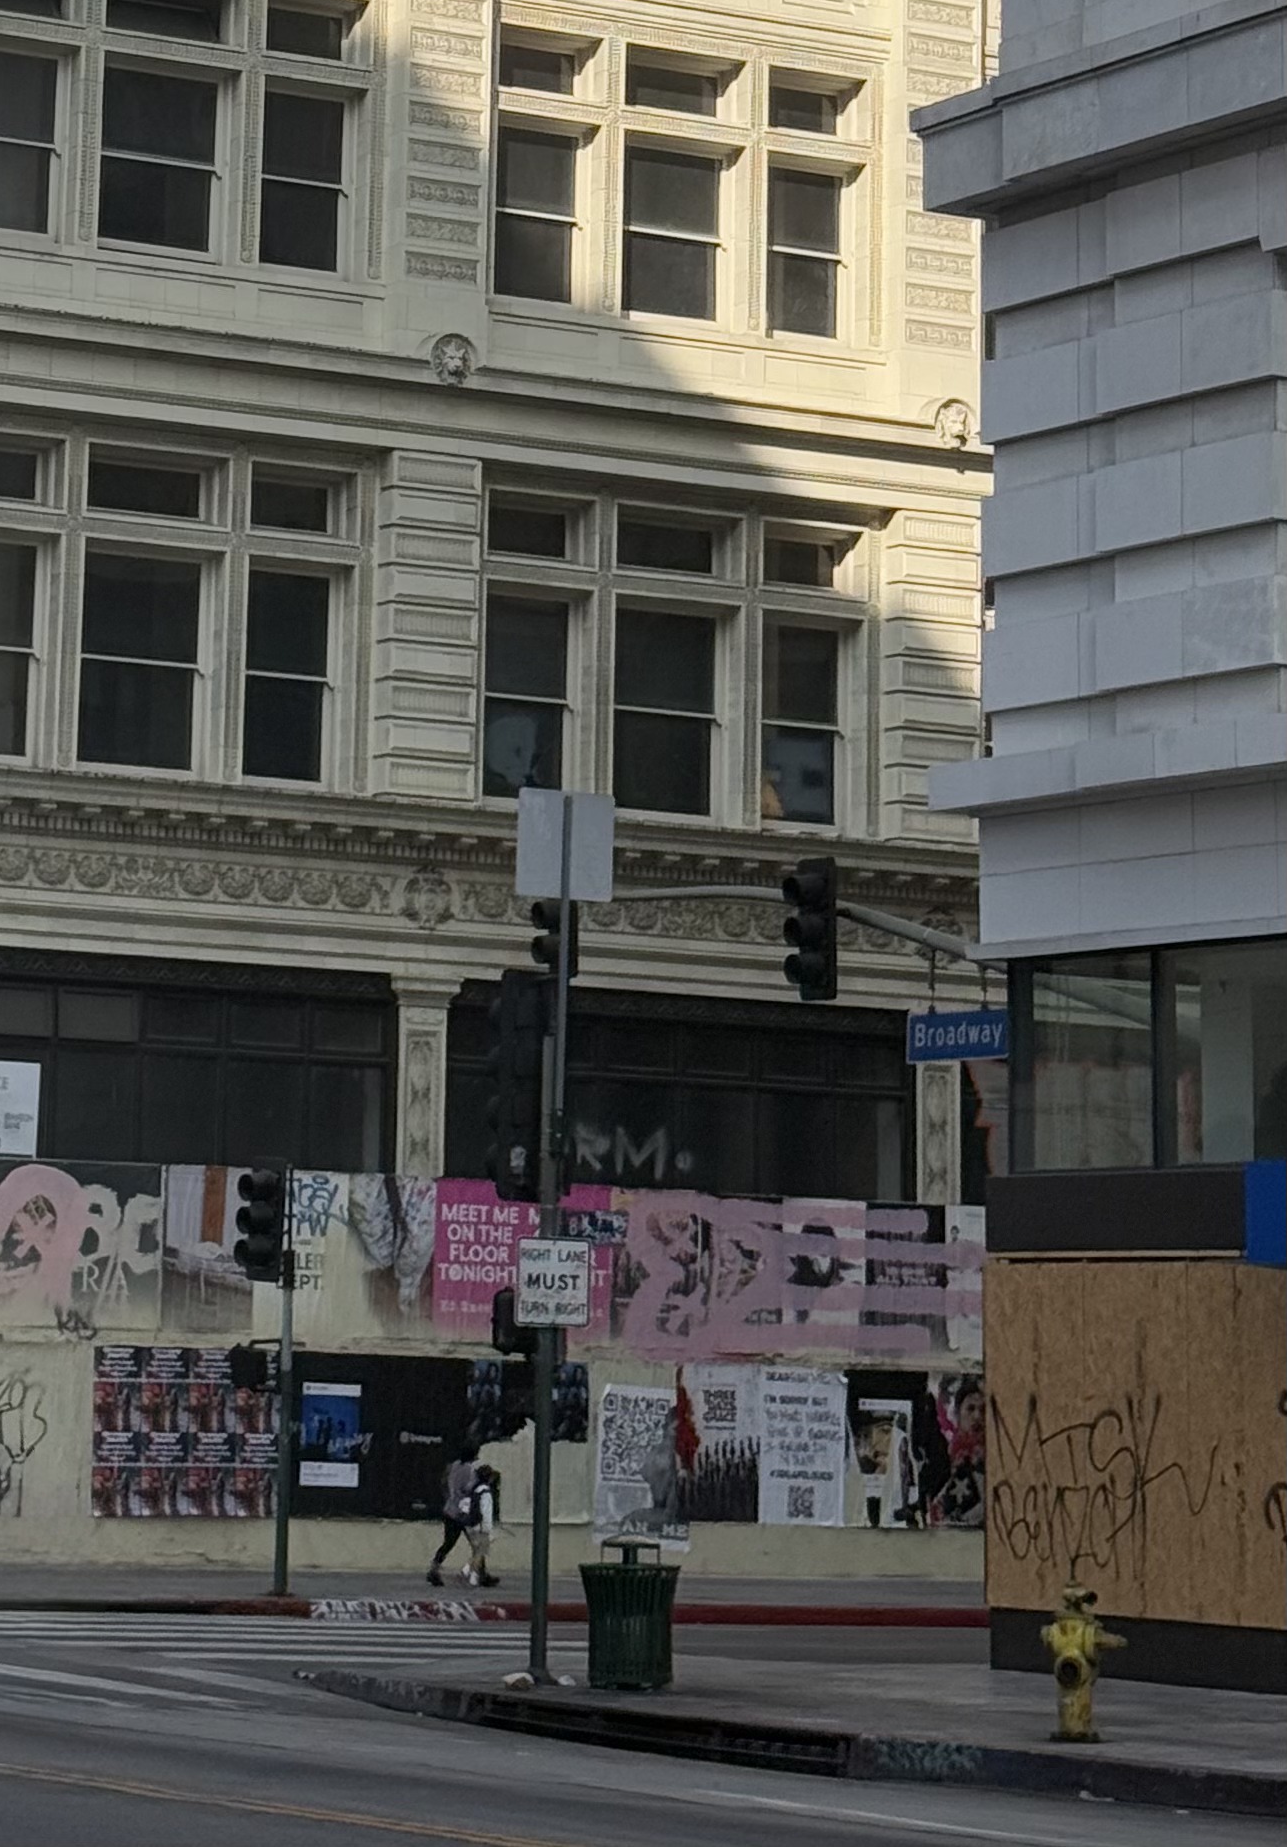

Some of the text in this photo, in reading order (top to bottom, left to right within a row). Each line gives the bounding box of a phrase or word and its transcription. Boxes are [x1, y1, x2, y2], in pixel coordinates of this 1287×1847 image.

[914, 1020, 1003, 1048] Broadway
[441, 1203, 489, 1223] MEET
[492, 1206, 520, 1225] ME
[447, 1223, 513, 1244] ON THE
[449, 1243, 510, 1263] FLOOR
[521, 1247, 587, 1264] RIGHT LANE
[438, 1263, 517, 1284] TONIGHT
[526, 1272, 580, 1291] MUST
[521, 1299, 587, 1316] TURN RIGHT
